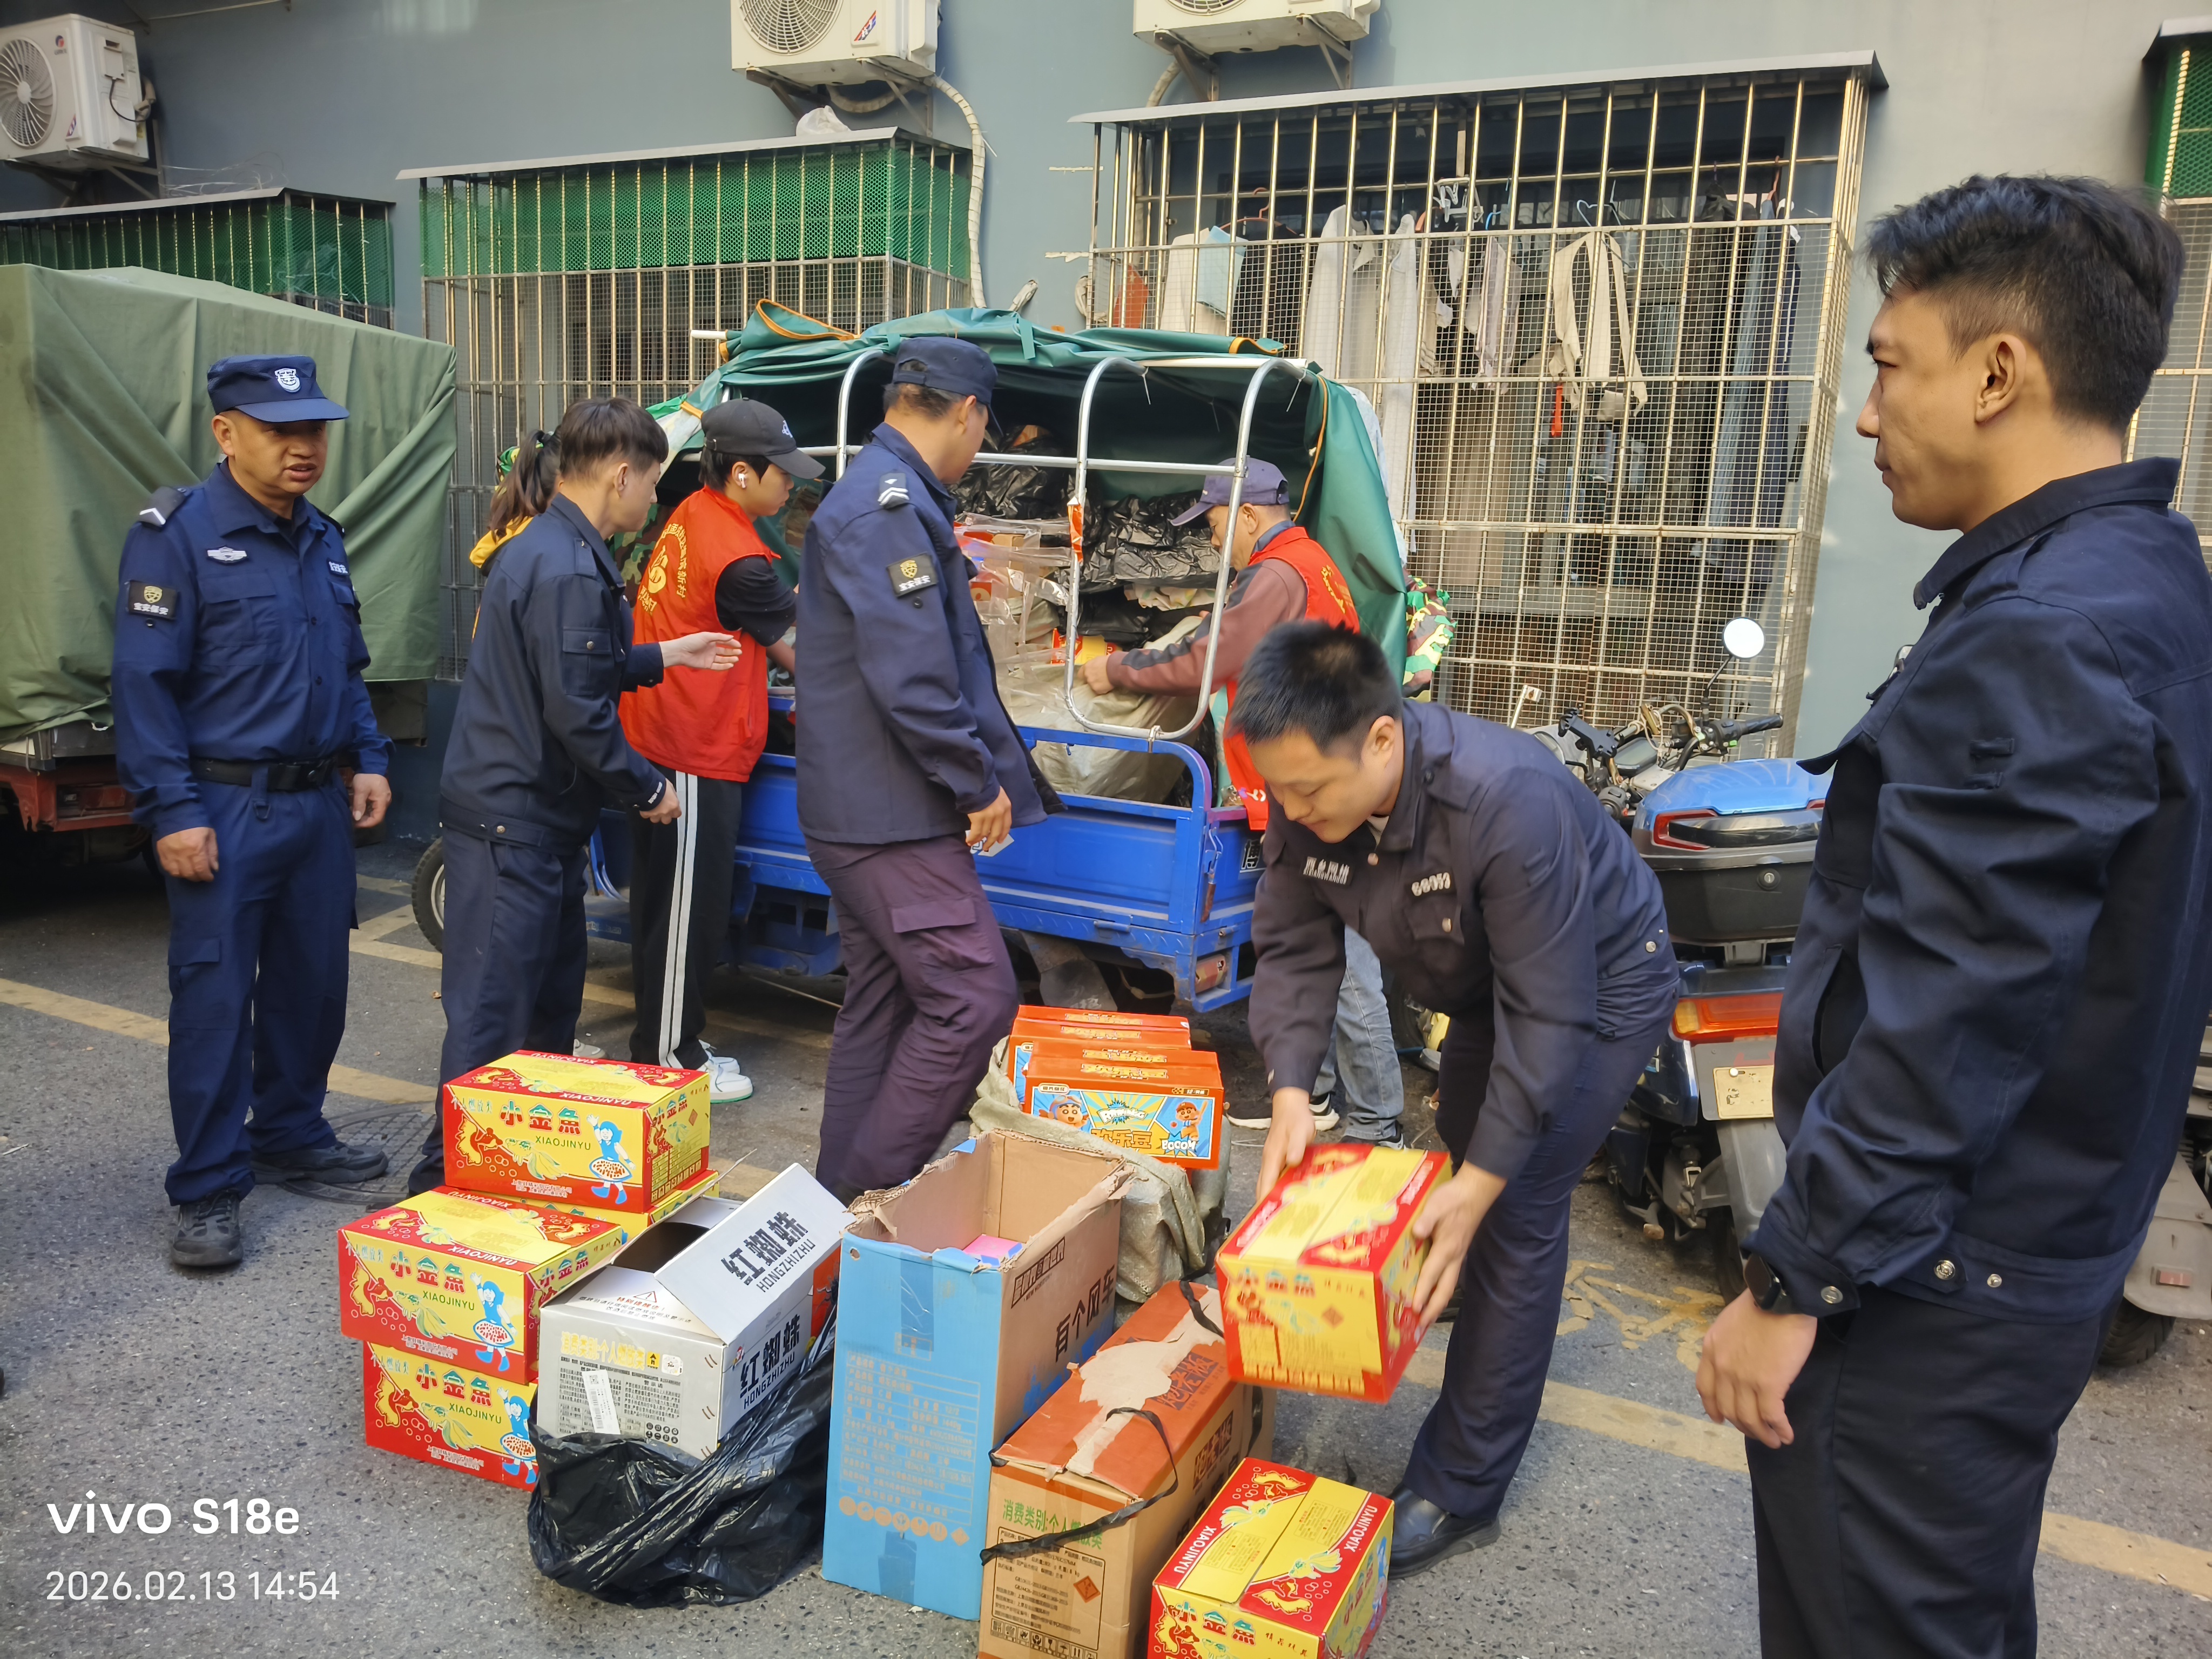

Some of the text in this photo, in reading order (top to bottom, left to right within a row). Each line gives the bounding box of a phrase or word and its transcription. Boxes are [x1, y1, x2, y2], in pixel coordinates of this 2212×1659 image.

[530, 1053, 598, 1064] XIAOJINYU
[559, 1092, 632, 1107] XIAOJINYU
[535, 1136, 591, 1150] XIAOJINYU
[1161, 1138, 1197, 1152] BOOOM
[447, 1191, 512, 1208] XIAOJINYU
[447, 1244, 517, 1266] XIAOJINYU
[721, 1212, 808, 1286] 红蜘蛛
[756, 1239, 815, 1292] HONGZHIZHU
[422, 1290, 474, 1311] XIAOJINYU
[1055, 1264, 1115, 1363] 有个风车
[740, 1314, 800, 1399] 红蜘蛛
[744, 1351, 795, 1410] HONGZHIZHU
[449, 1403, 502, 1424] XIAOJINYU
[1344, 1505, 1378, 1553] XIAOJINYU
[1174, 1525, 1217, 1574] XIAOJINYU
